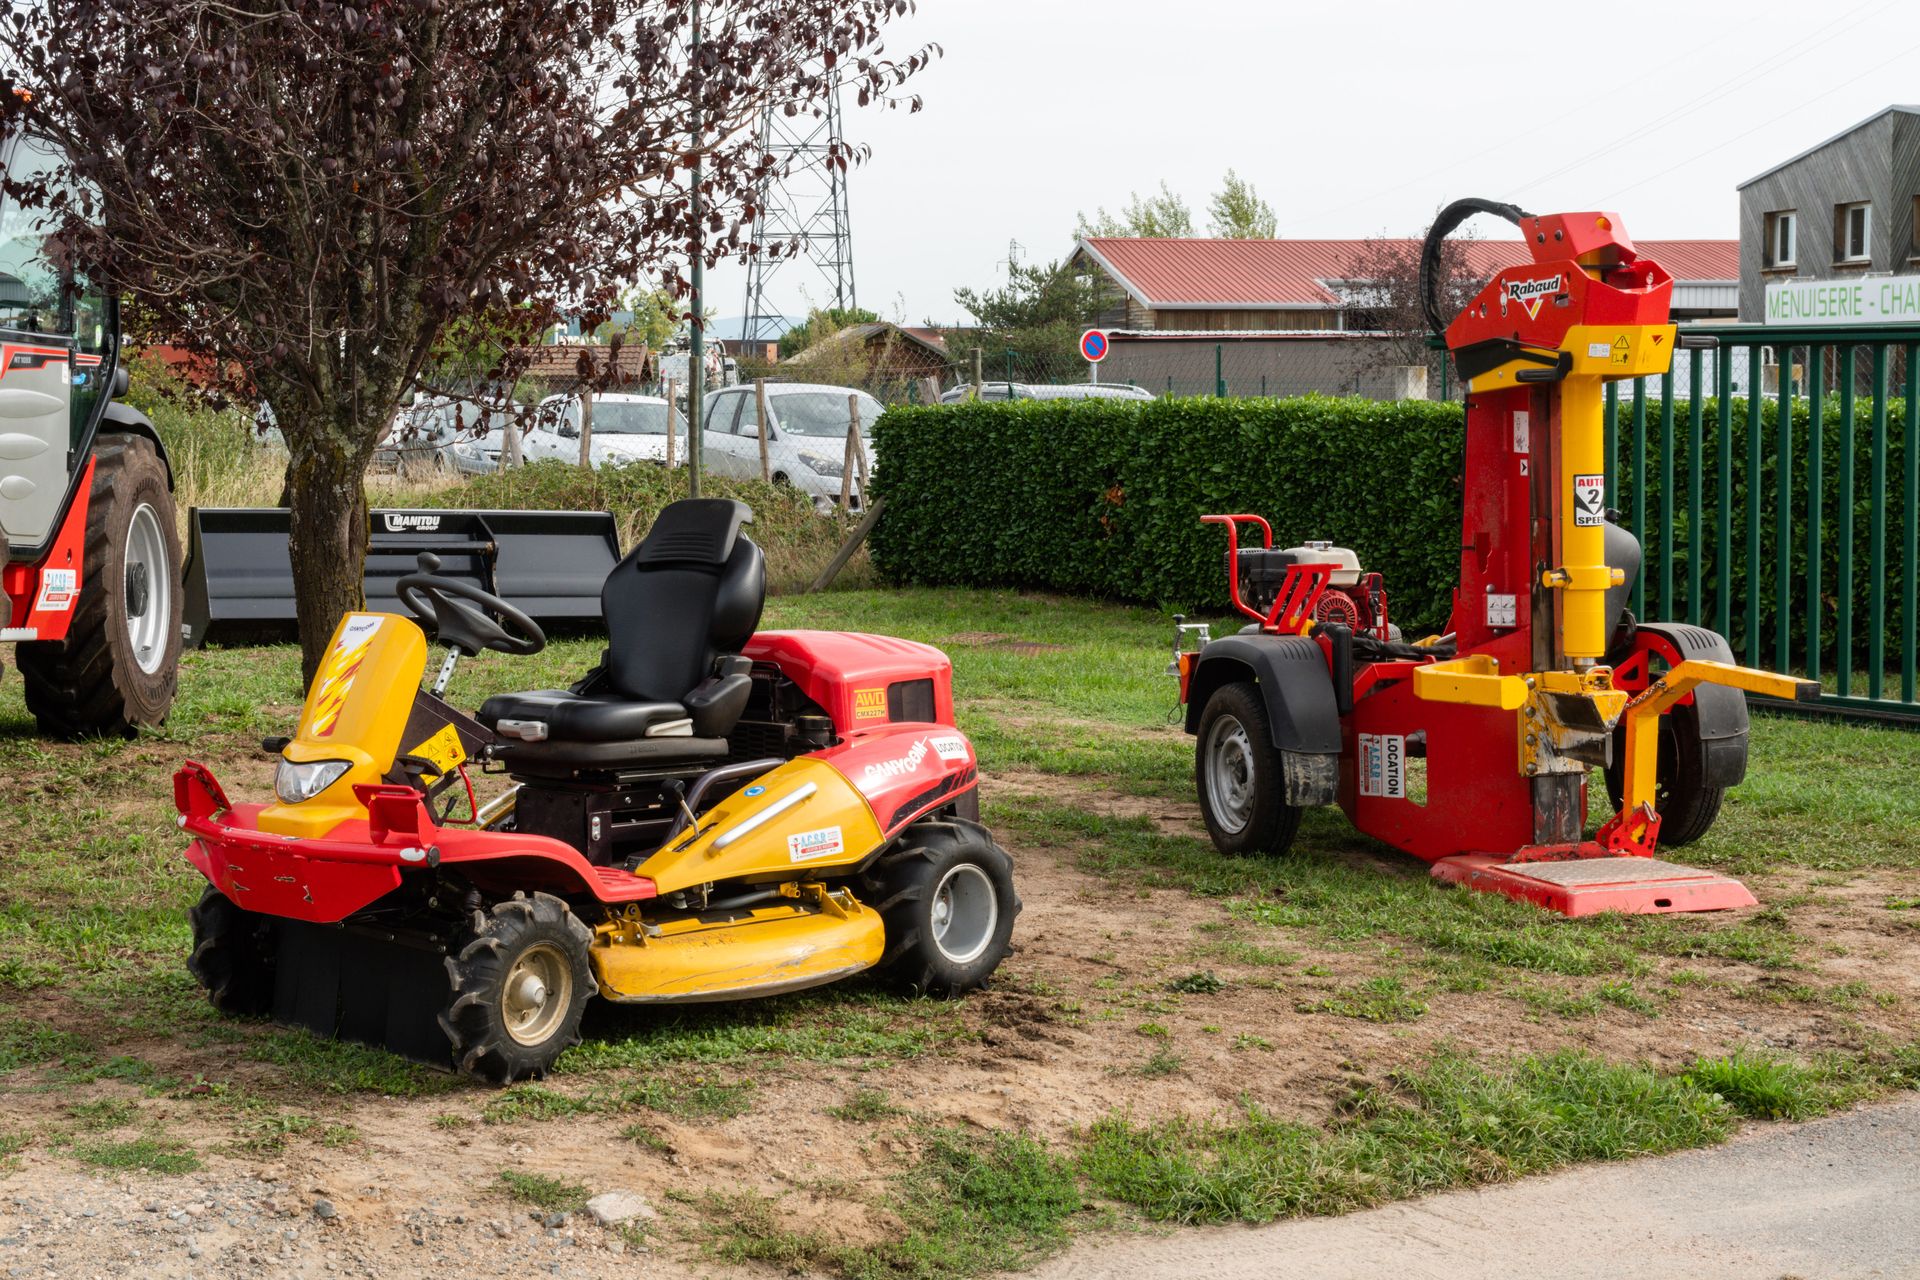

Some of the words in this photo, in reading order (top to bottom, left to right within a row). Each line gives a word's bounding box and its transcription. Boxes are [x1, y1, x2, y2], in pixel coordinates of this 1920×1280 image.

[1509, 277, 1559, 300] Rabaud
[1768, 286, 1862, 318] MENUISERIE
[1881, 283, 1920, 314] CHA
[1587, 488, 1600, 505] 2
[392, 515, 440, 526] MANITOU
[856, 691, 885, 707] AWD
[856, 709, 885, 718] CMX227H
[935, 742, 966, 754] LOCATION
[864, 737, 929, 777] CANYCOM
[1387, 738, 1399, 796] LOCATION
